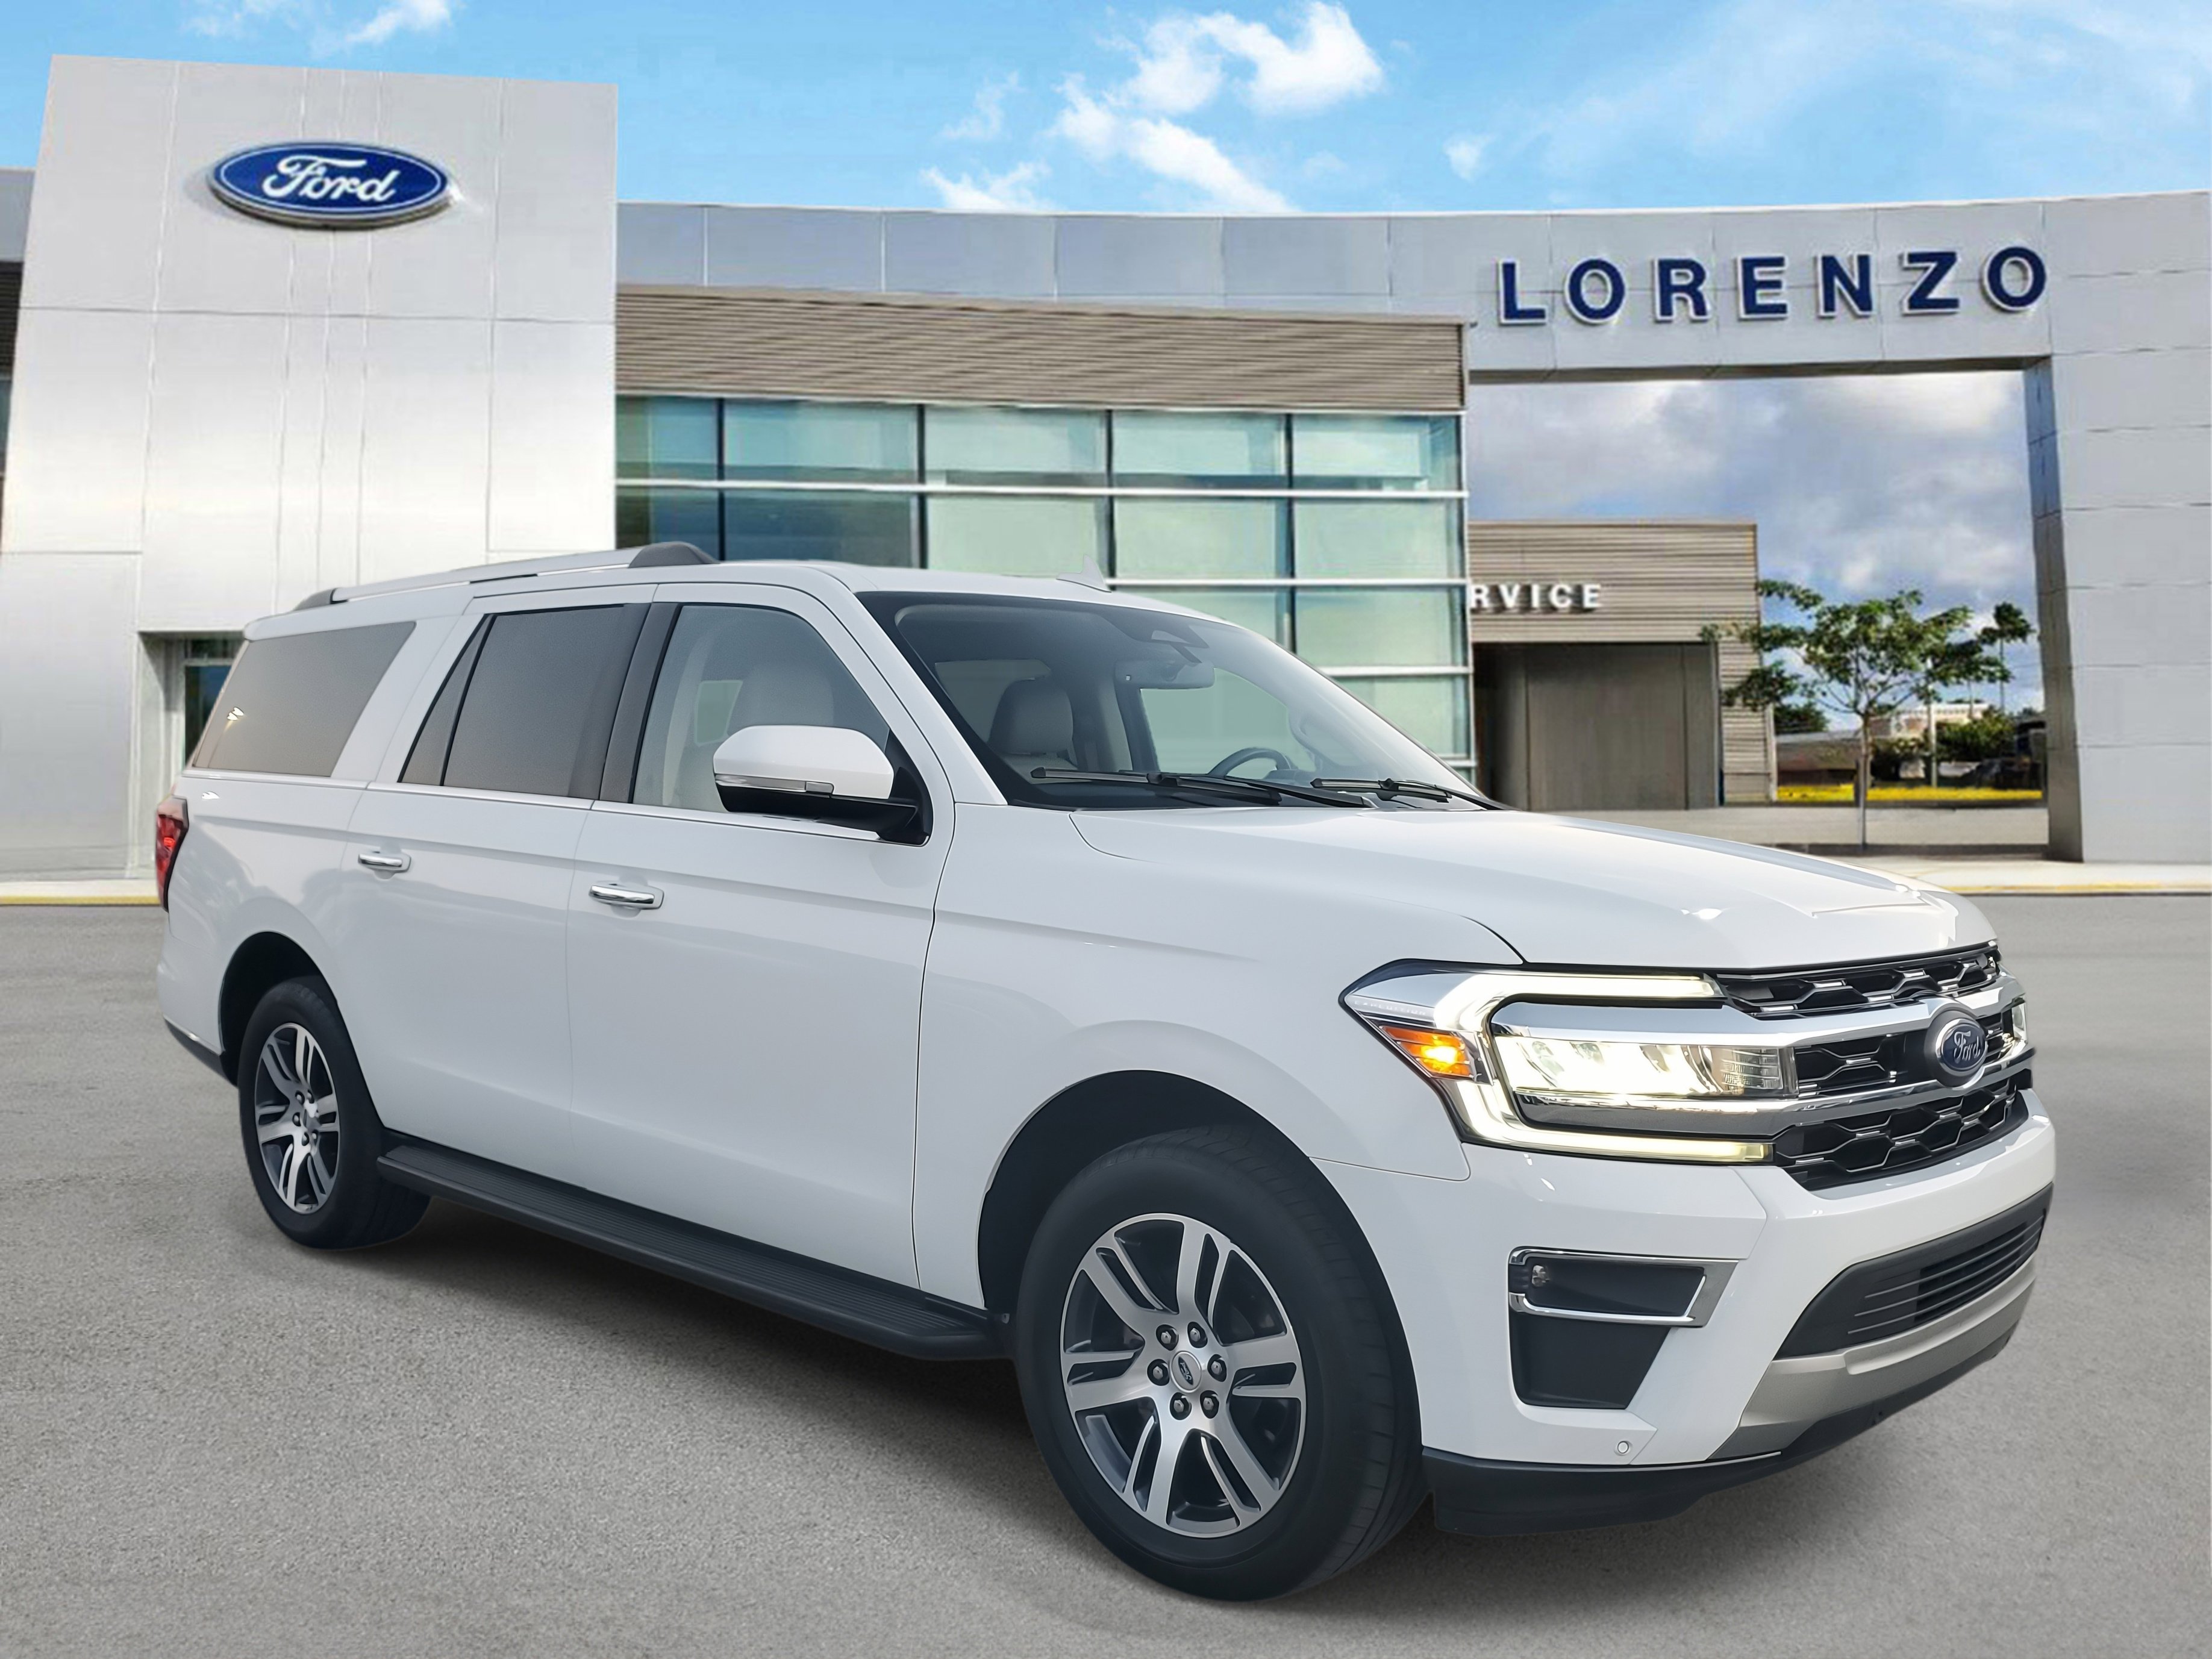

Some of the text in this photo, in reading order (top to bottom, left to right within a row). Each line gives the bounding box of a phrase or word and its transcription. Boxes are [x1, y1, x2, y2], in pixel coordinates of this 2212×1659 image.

[261, 154, 401, 202] Ford
[1499, 246, 2048, 323] LORENZO
[1954, 1031, 1981, 1064] Ford
